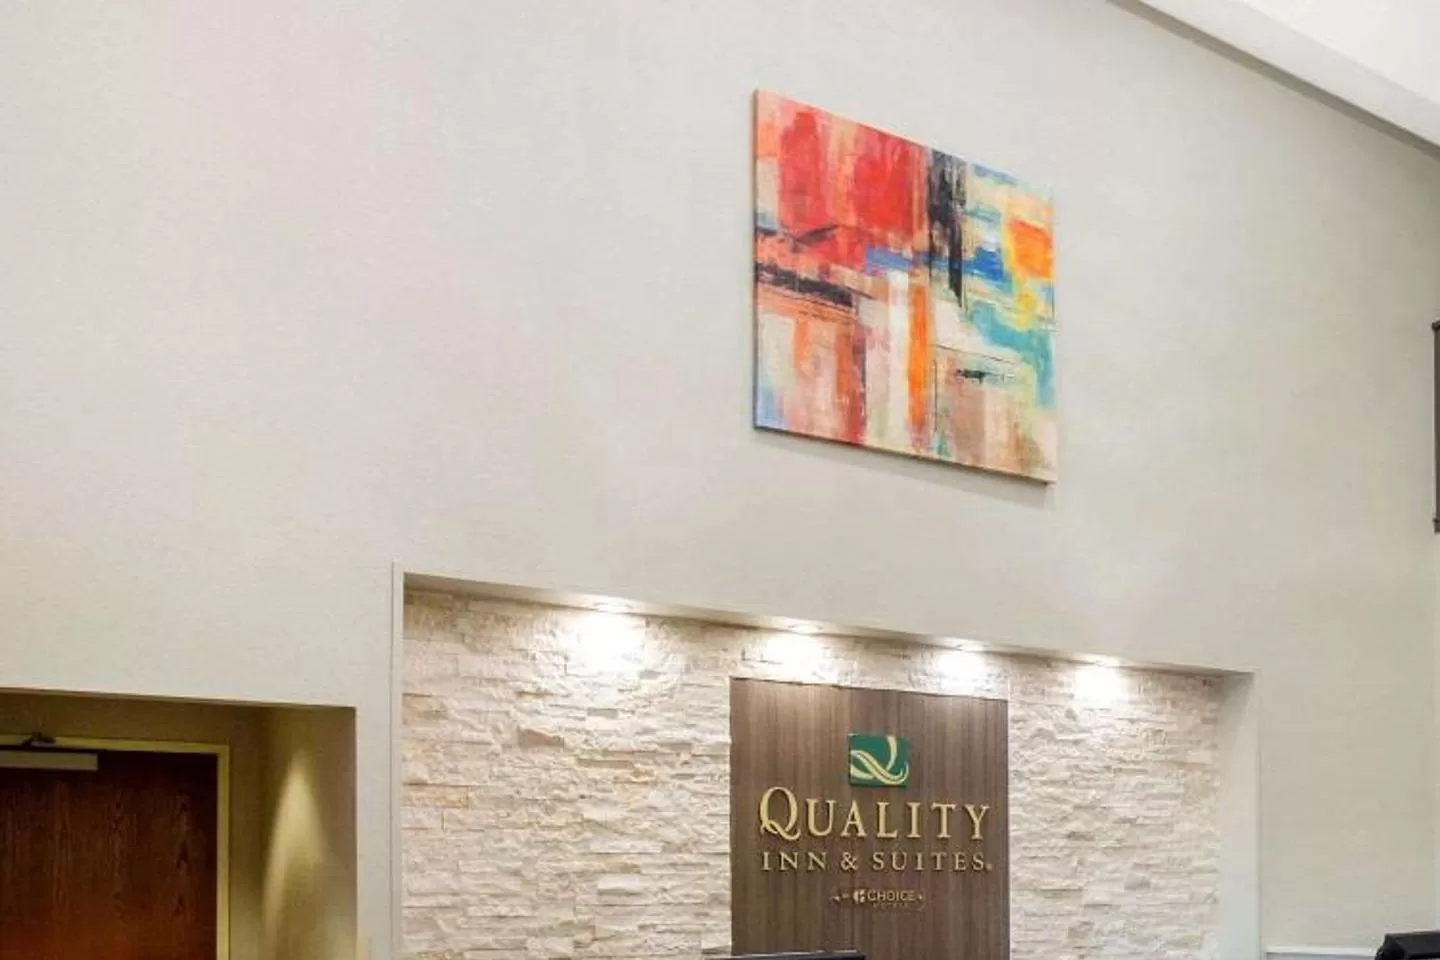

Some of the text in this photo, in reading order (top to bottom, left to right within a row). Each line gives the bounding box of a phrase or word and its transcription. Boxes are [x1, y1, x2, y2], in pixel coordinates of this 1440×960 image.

[759, 786, 990, 840] QUALITY
[762, 851, 986, 871] INN & SUITES
[867, 889, 915, 901] CHOICE
